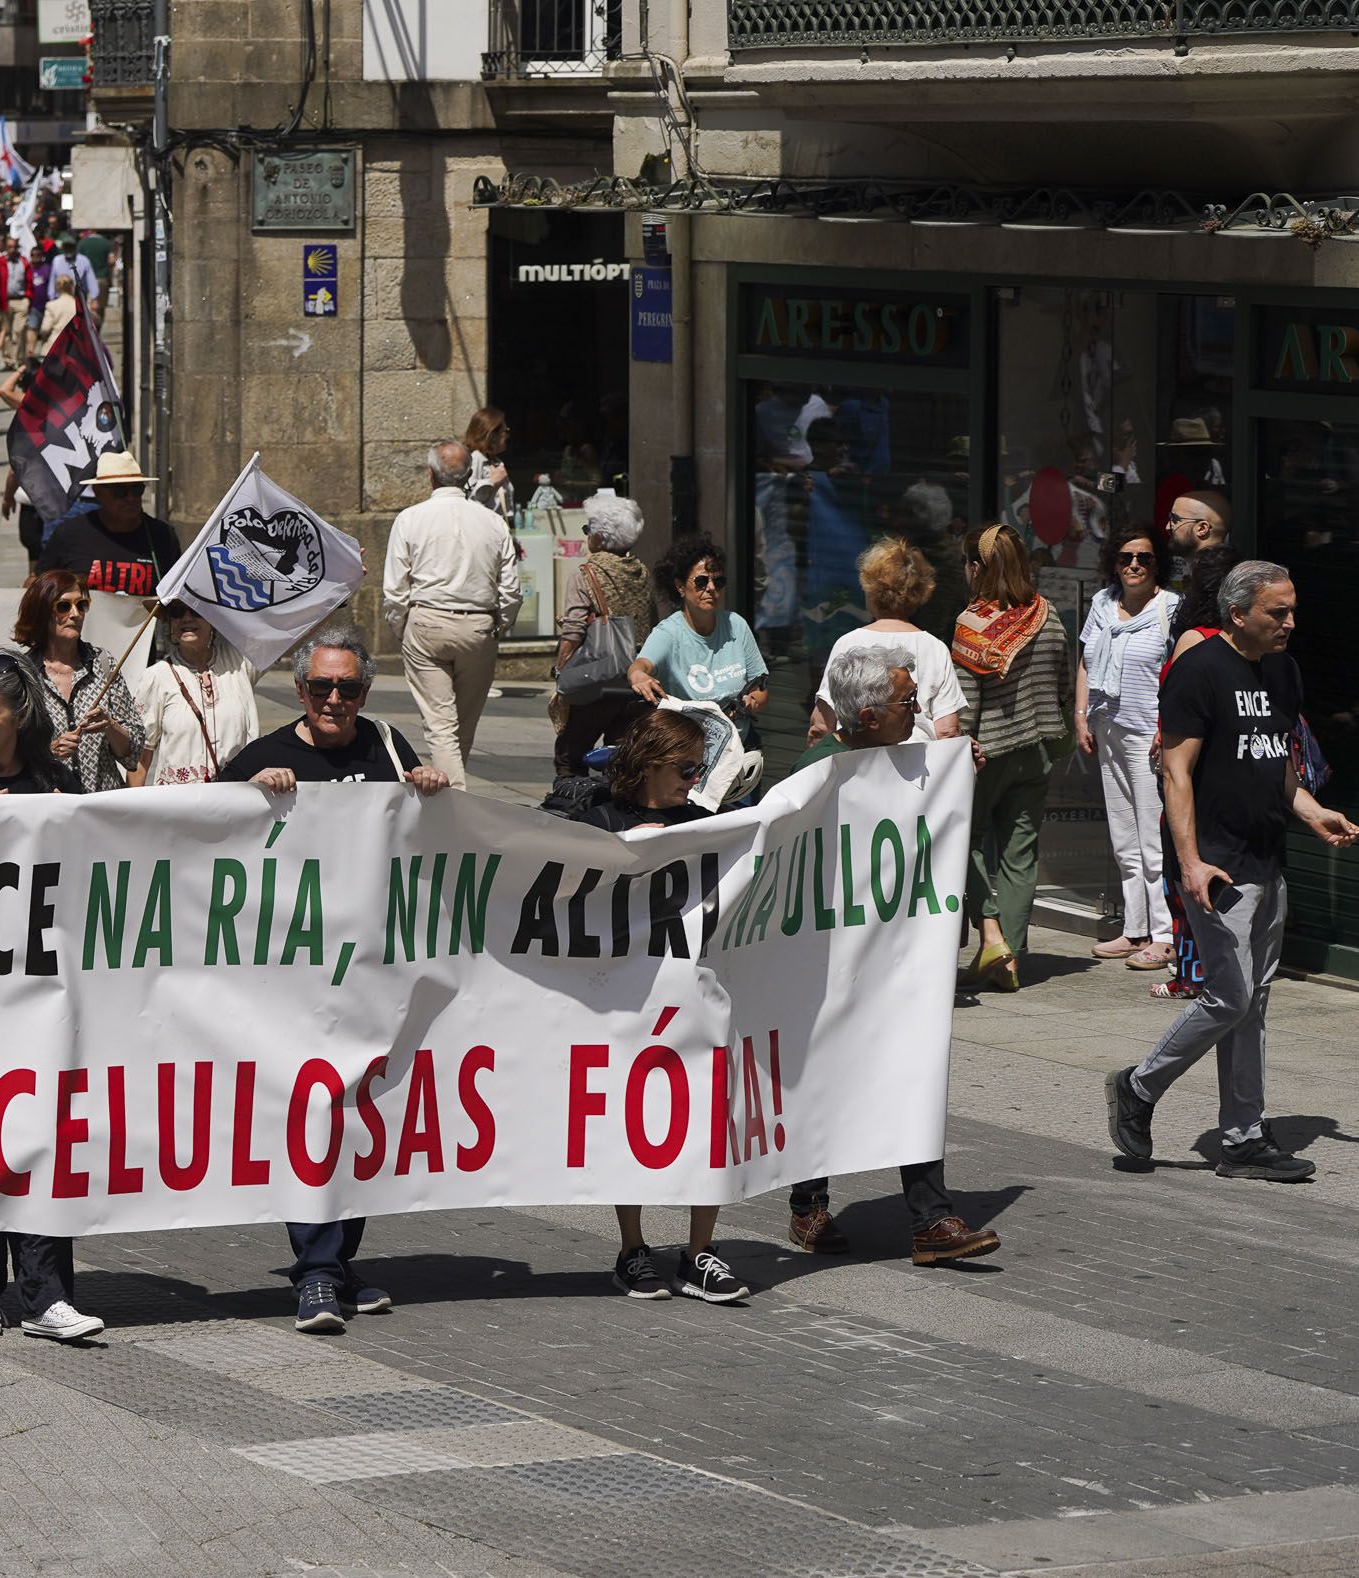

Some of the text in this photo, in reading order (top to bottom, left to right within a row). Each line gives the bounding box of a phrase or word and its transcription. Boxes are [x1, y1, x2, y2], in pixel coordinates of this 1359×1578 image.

[283, 163, 323, 174] PASEO
[293, 178, 311, 189] DE
[274, 193, 332, 205] ANTONIO
[265, 209, 340, 220] ODRIOZOLA
[755, 296, 939, 357] ARESSO
[87, 559, 153, 597] ALTRI
[1234, 690, 1272, 717] ENCE
[81, 861, 173, 970] NA
[204, 821, 355, 986] RÍA,
[384, 853, 500, 964] NIN
[510, 852, 719, 960] ALTRI
[722, 846, 783, 950] NA
[781, 814, 959, 936] ULLOA.
[566, 1006, 786, 1170] FÓRA!
